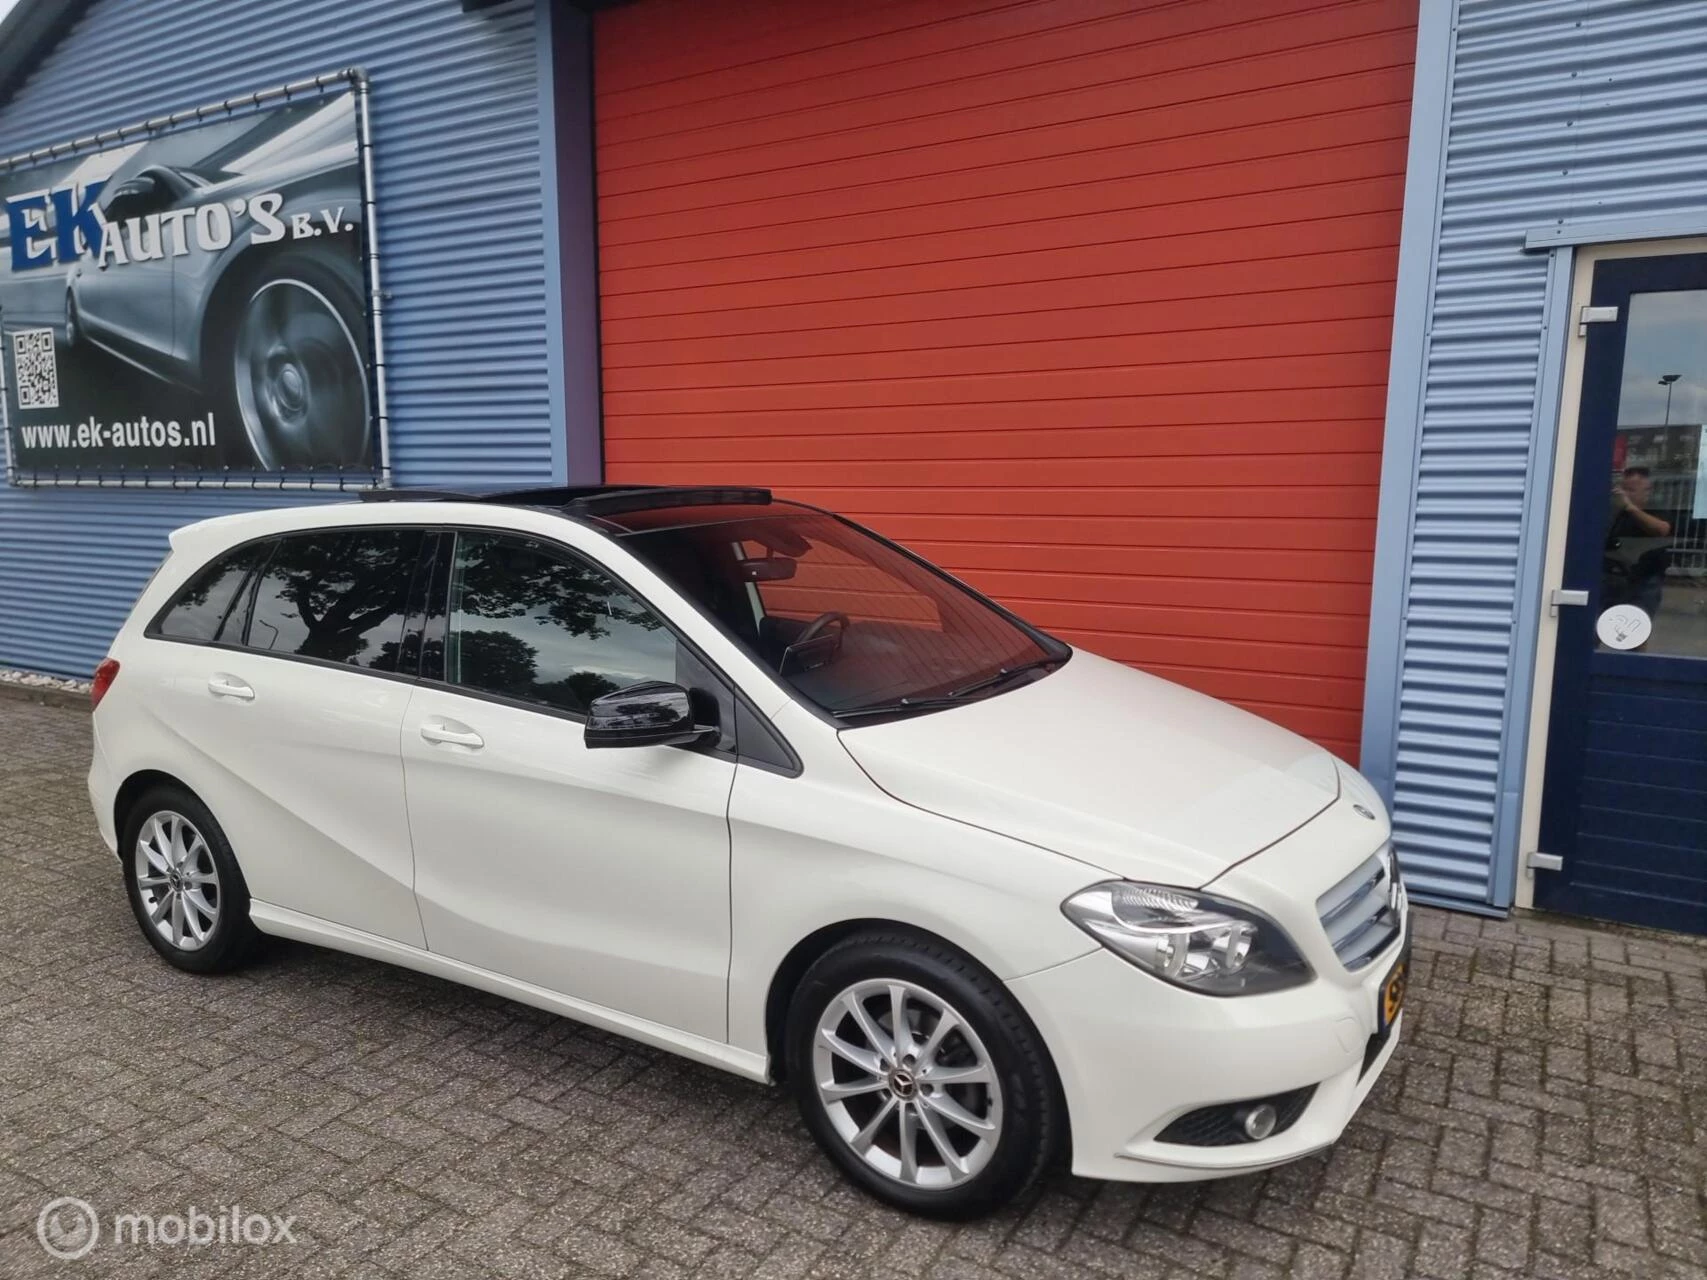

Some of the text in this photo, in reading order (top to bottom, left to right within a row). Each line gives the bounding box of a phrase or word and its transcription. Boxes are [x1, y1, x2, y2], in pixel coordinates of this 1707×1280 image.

[7, 179, 110, 271] EK
[291, 207, 354, 240] B.V.
[21, 411, 216, 448] www.ek-autos.nl
